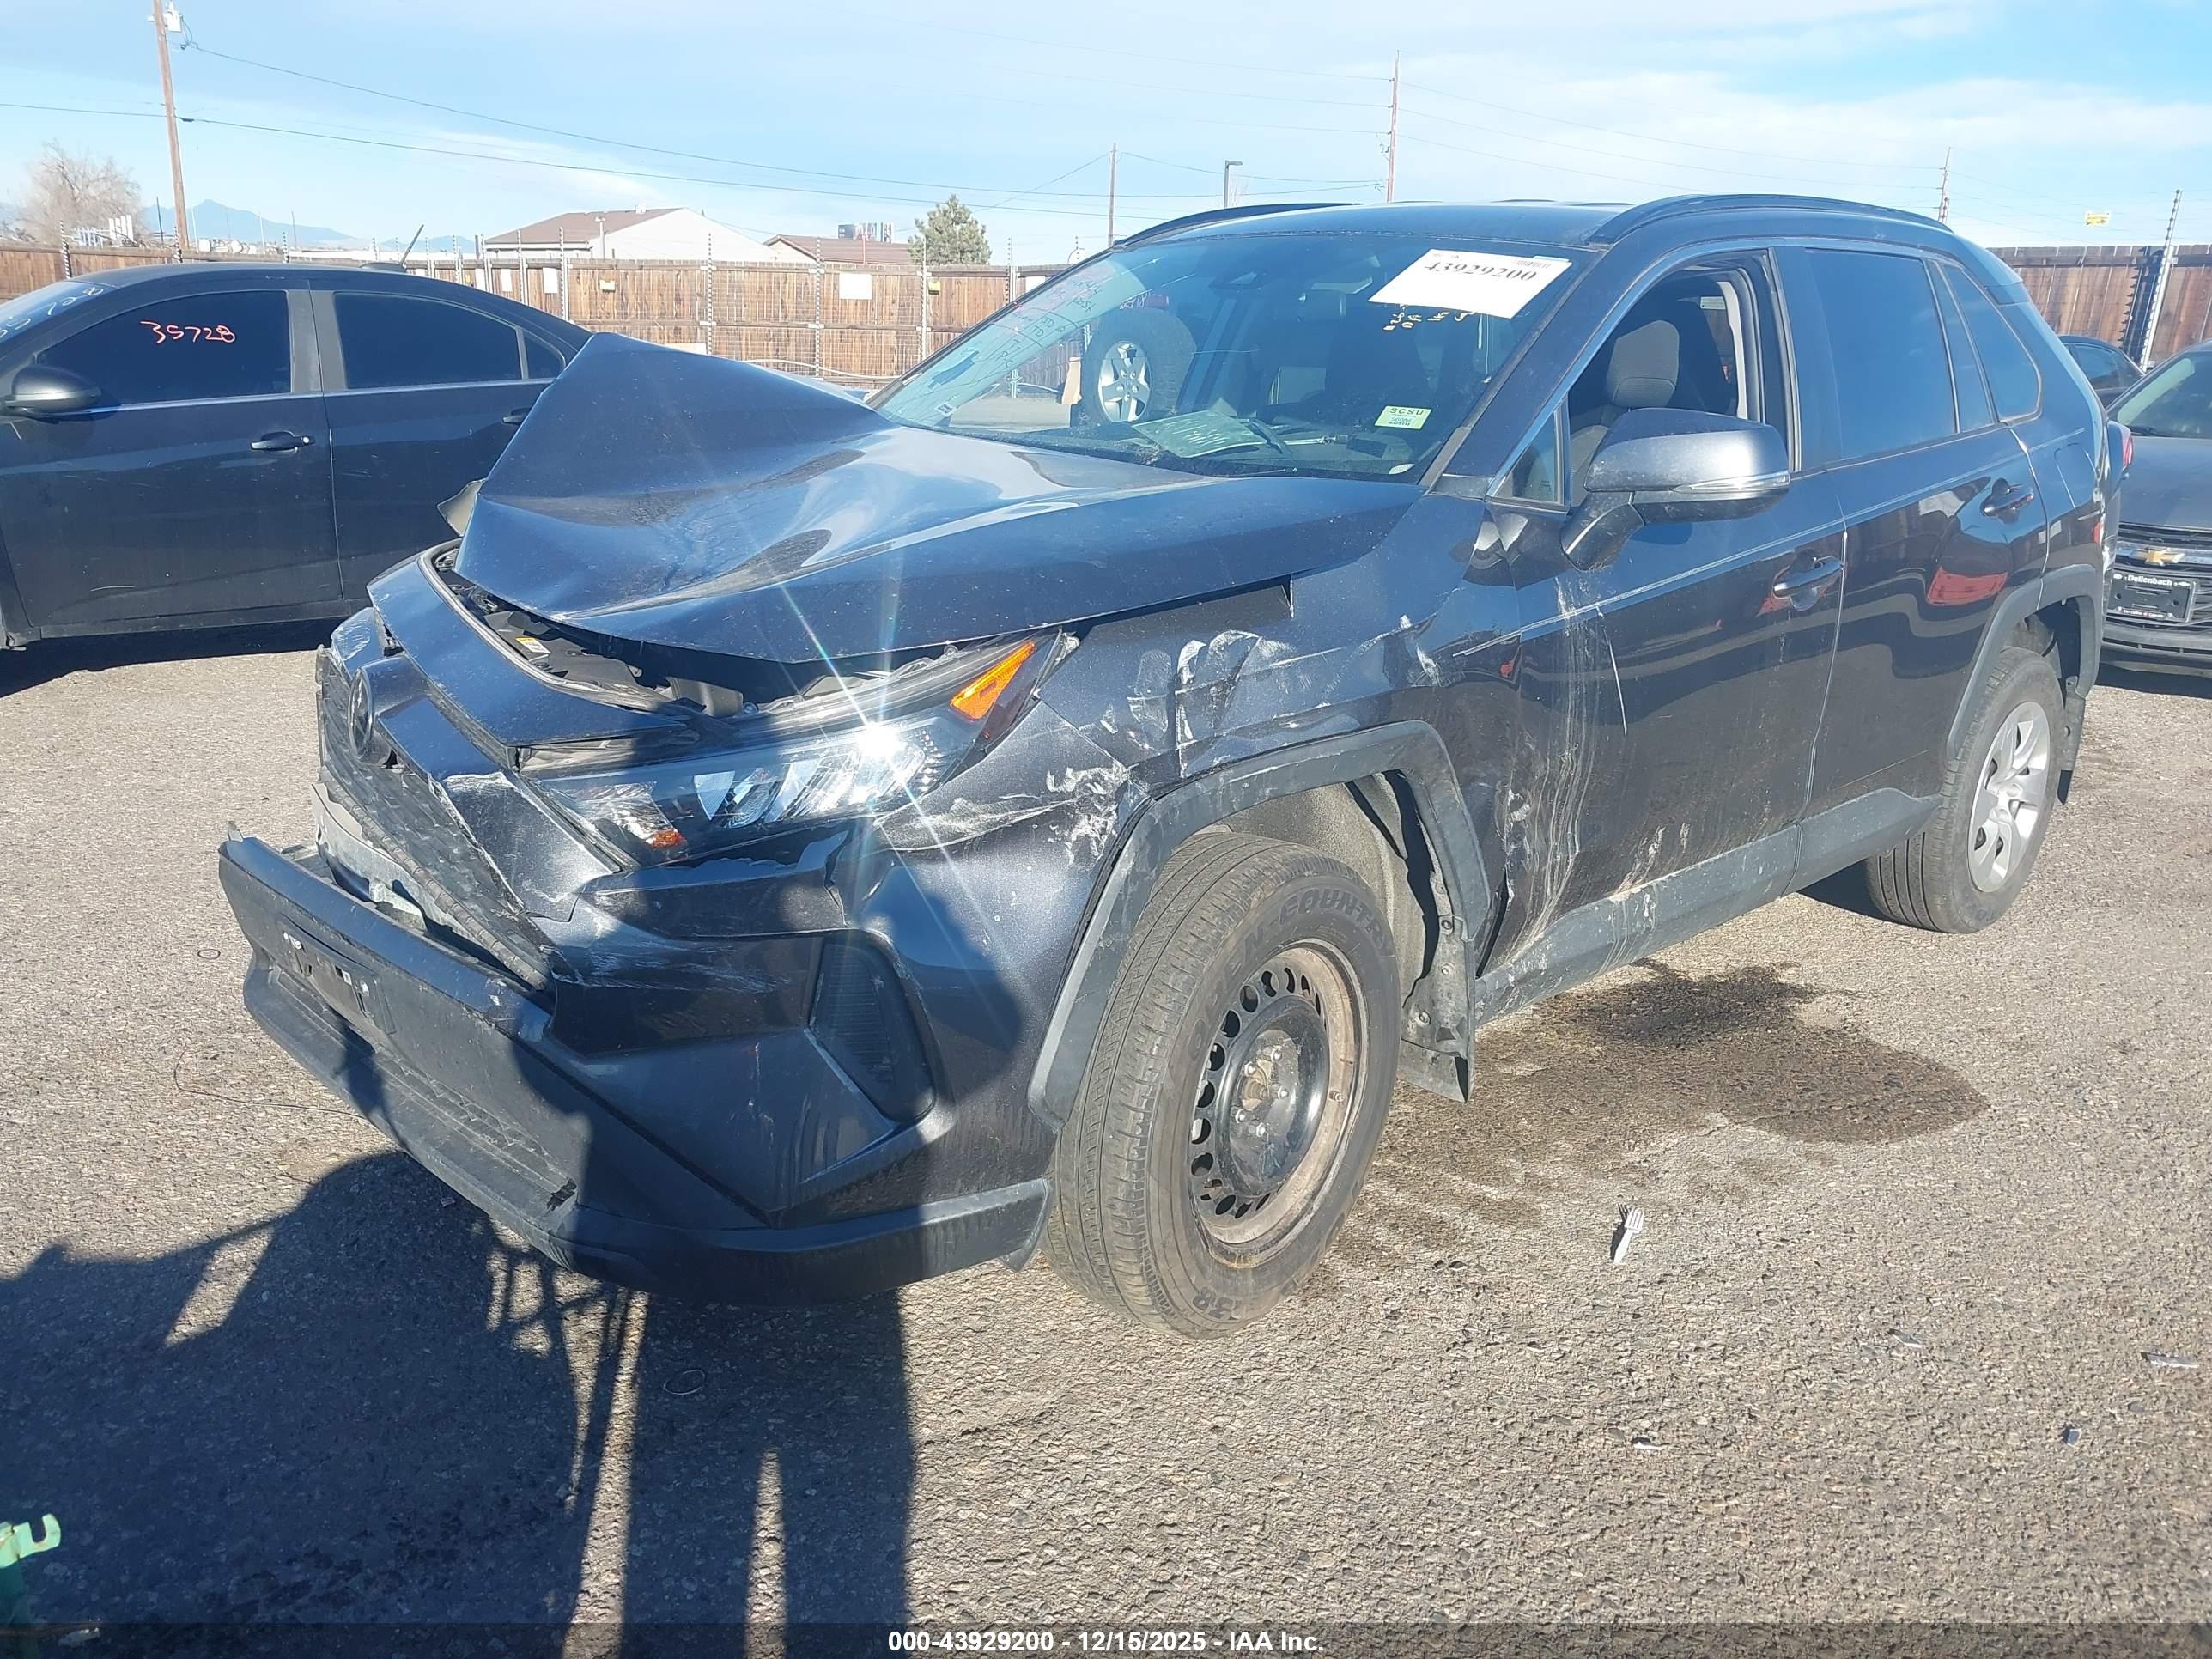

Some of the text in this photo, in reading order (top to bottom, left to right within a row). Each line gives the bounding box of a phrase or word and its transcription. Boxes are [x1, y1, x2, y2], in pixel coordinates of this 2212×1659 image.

[1424, 262, 1537, 281] 43929200
[140, 321, 235, 344] 35728
[1389, 407, 1425, 416] SCSU
[2127, 574, 2172, 586] Dellenbach
